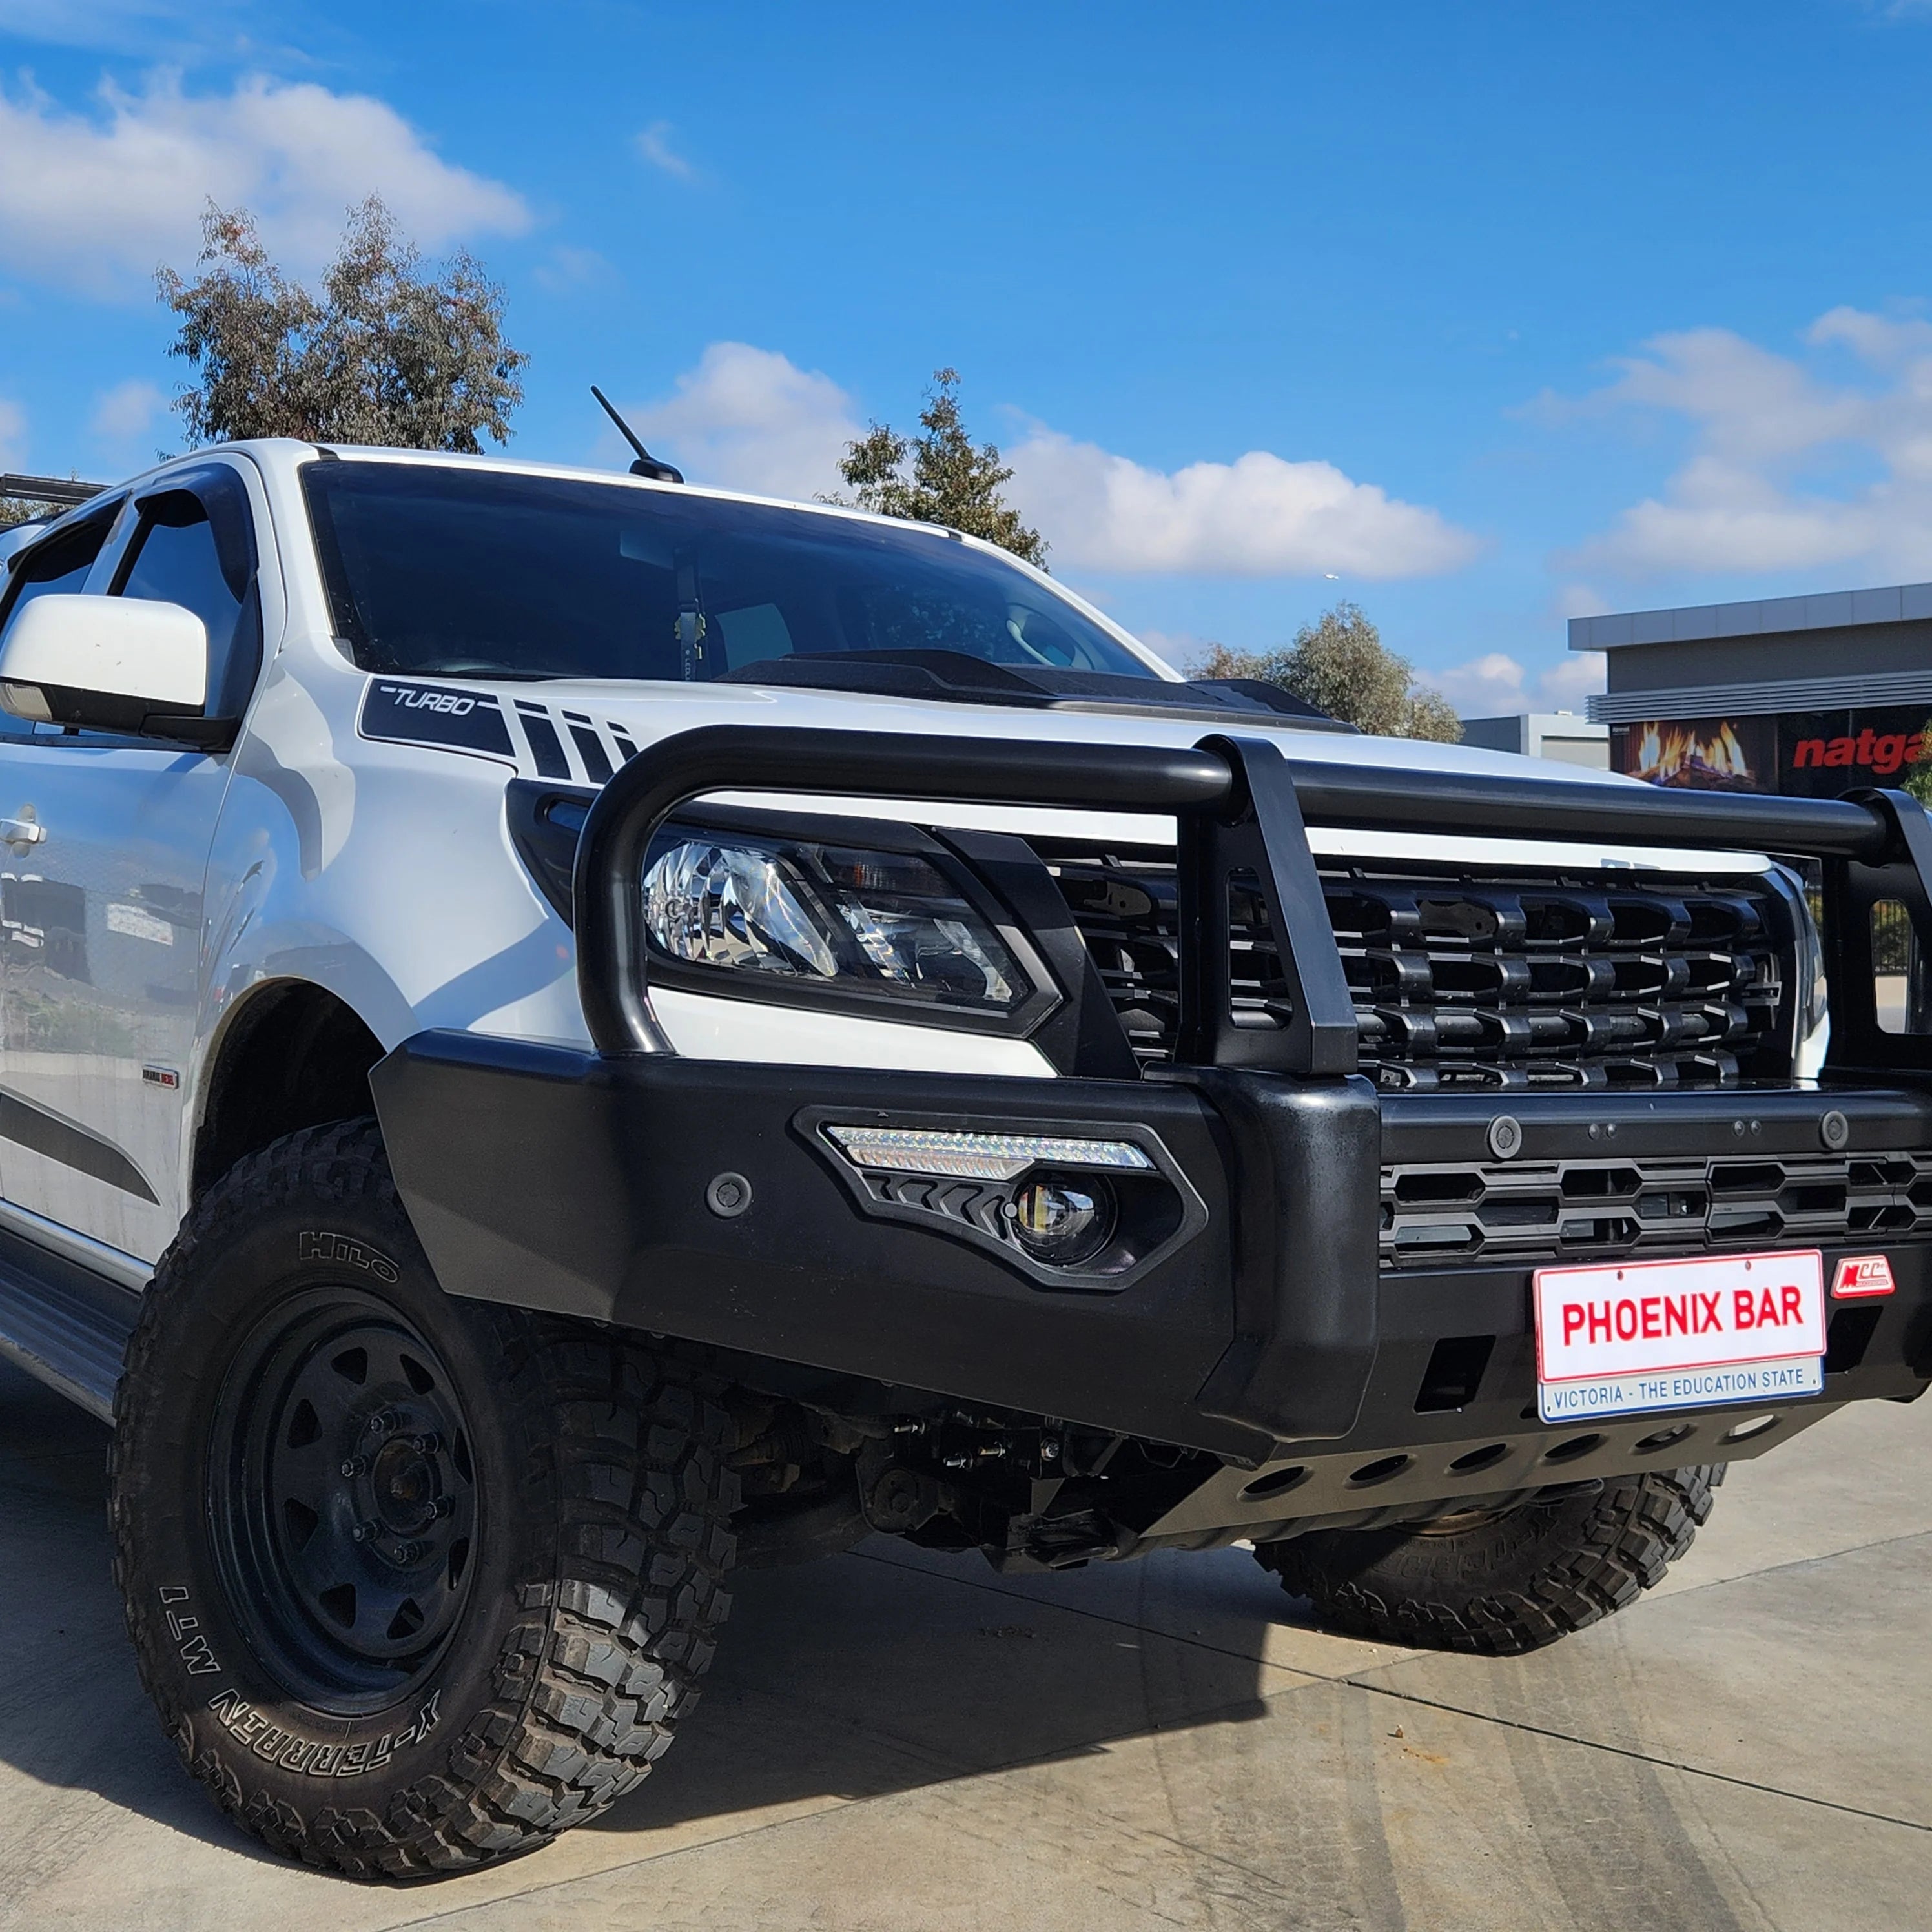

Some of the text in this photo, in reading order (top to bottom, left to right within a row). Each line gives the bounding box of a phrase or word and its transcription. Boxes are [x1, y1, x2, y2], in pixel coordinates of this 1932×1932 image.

[393, 688, 477, 716] TURBO
[299, 1231, 400, 1283] HILO
[1562, 1285, 1803, 1346] PHOENIX BAR
[1554, 1386, 1623, 1409] VICTORIA
[1638, 1381, 1668, 1399] THE
[1673, 1373, 1757, 1396] EDUCATION
[1762, 1368, 1804, 1388] STATE
[207, 1687, 441, 1778] X-TERRAIN
